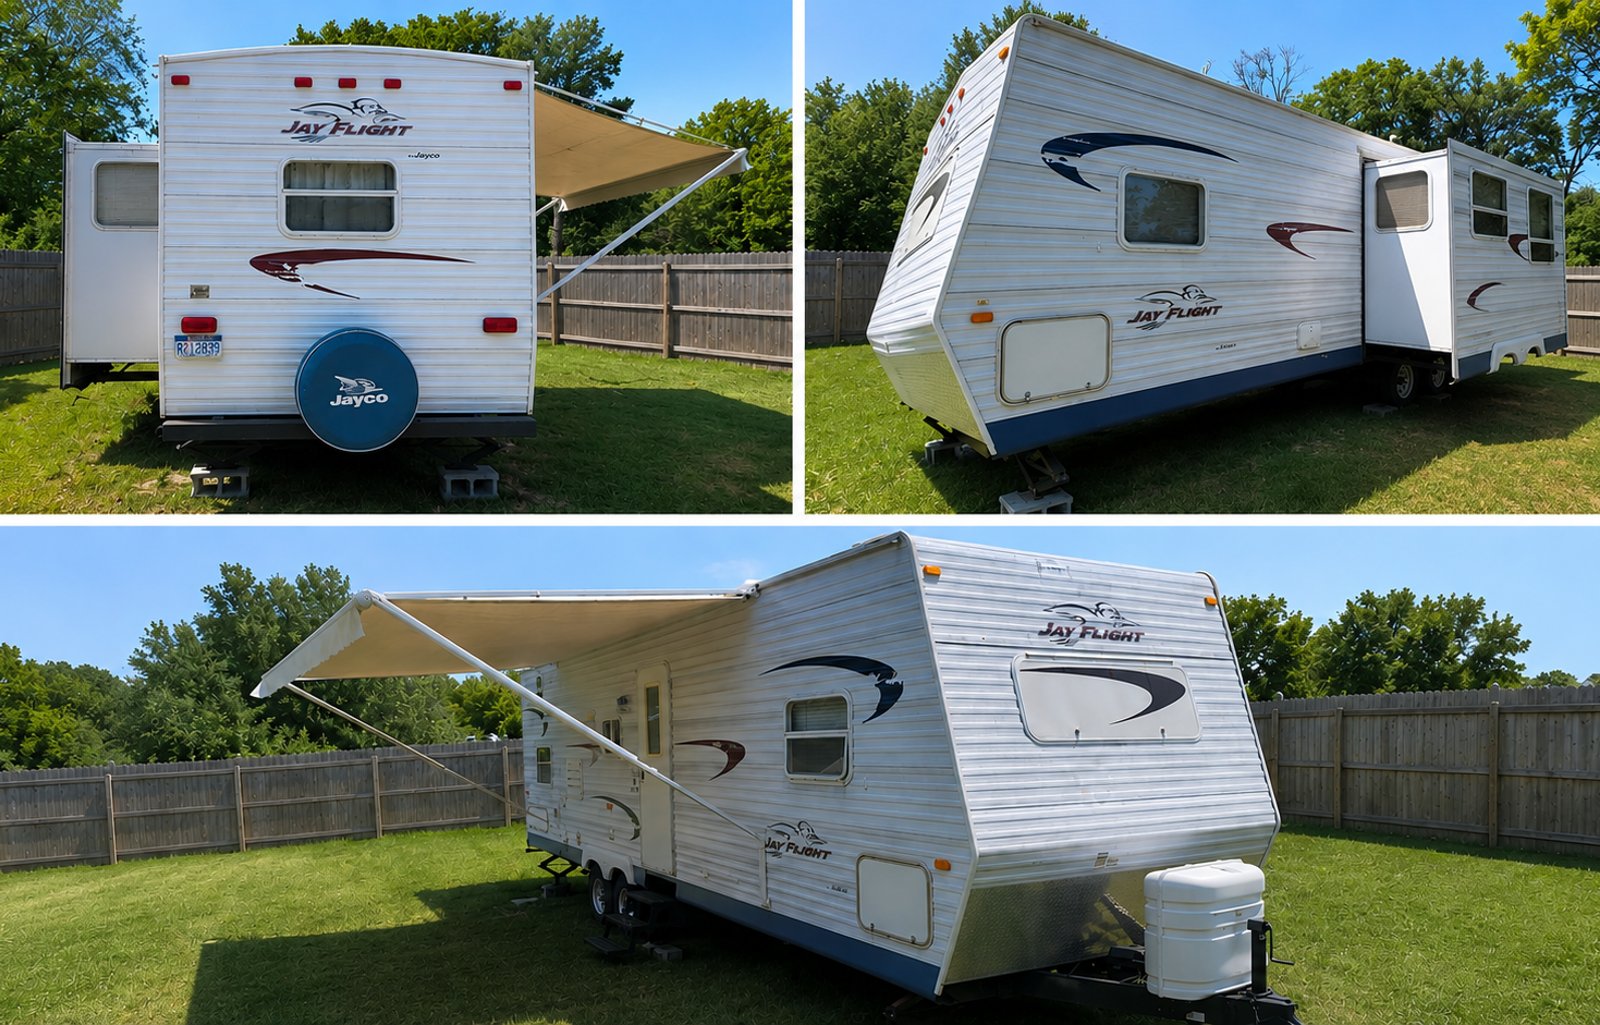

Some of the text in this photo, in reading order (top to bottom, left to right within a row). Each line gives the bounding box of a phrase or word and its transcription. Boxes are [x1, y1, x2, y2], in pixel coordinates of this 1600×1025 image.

[281, 121, 413, 136] JAY FLIGHT
[414, 151, 440, 160] Jayco
[1126, 305, 1223, 323] JAY FLIGHT
[329, 393, 389, 408] Jayco
[1038, 622, 1145, 642] JAY FLIGHT
